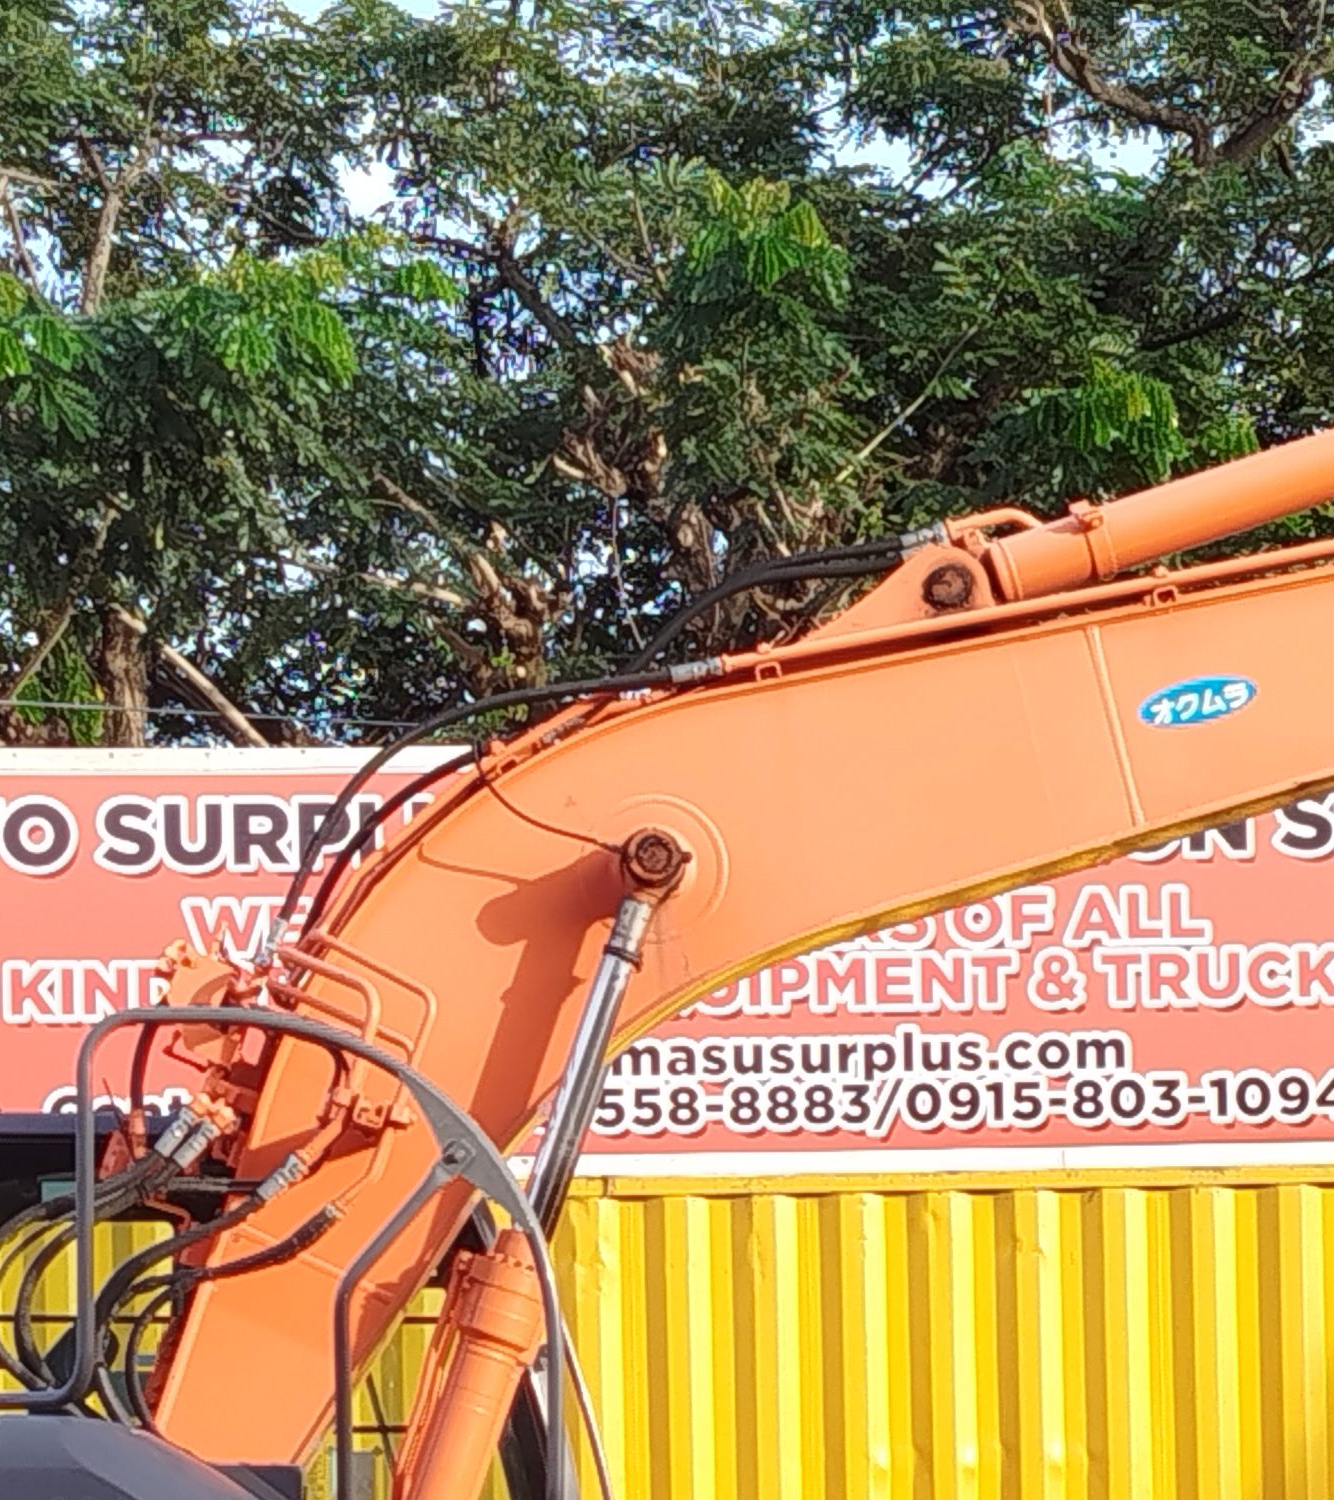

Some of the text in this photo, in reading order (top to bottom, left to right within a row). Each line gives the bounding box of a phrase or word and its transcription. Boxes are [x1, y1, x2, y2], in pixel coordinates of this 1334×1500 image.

[1149, 681, 1250, 725] オクムラ
[952, 891, 1049, 943] OF
[1071, 889, 1206, 941] ALL
[1037, 954, 1083, 1005] &
